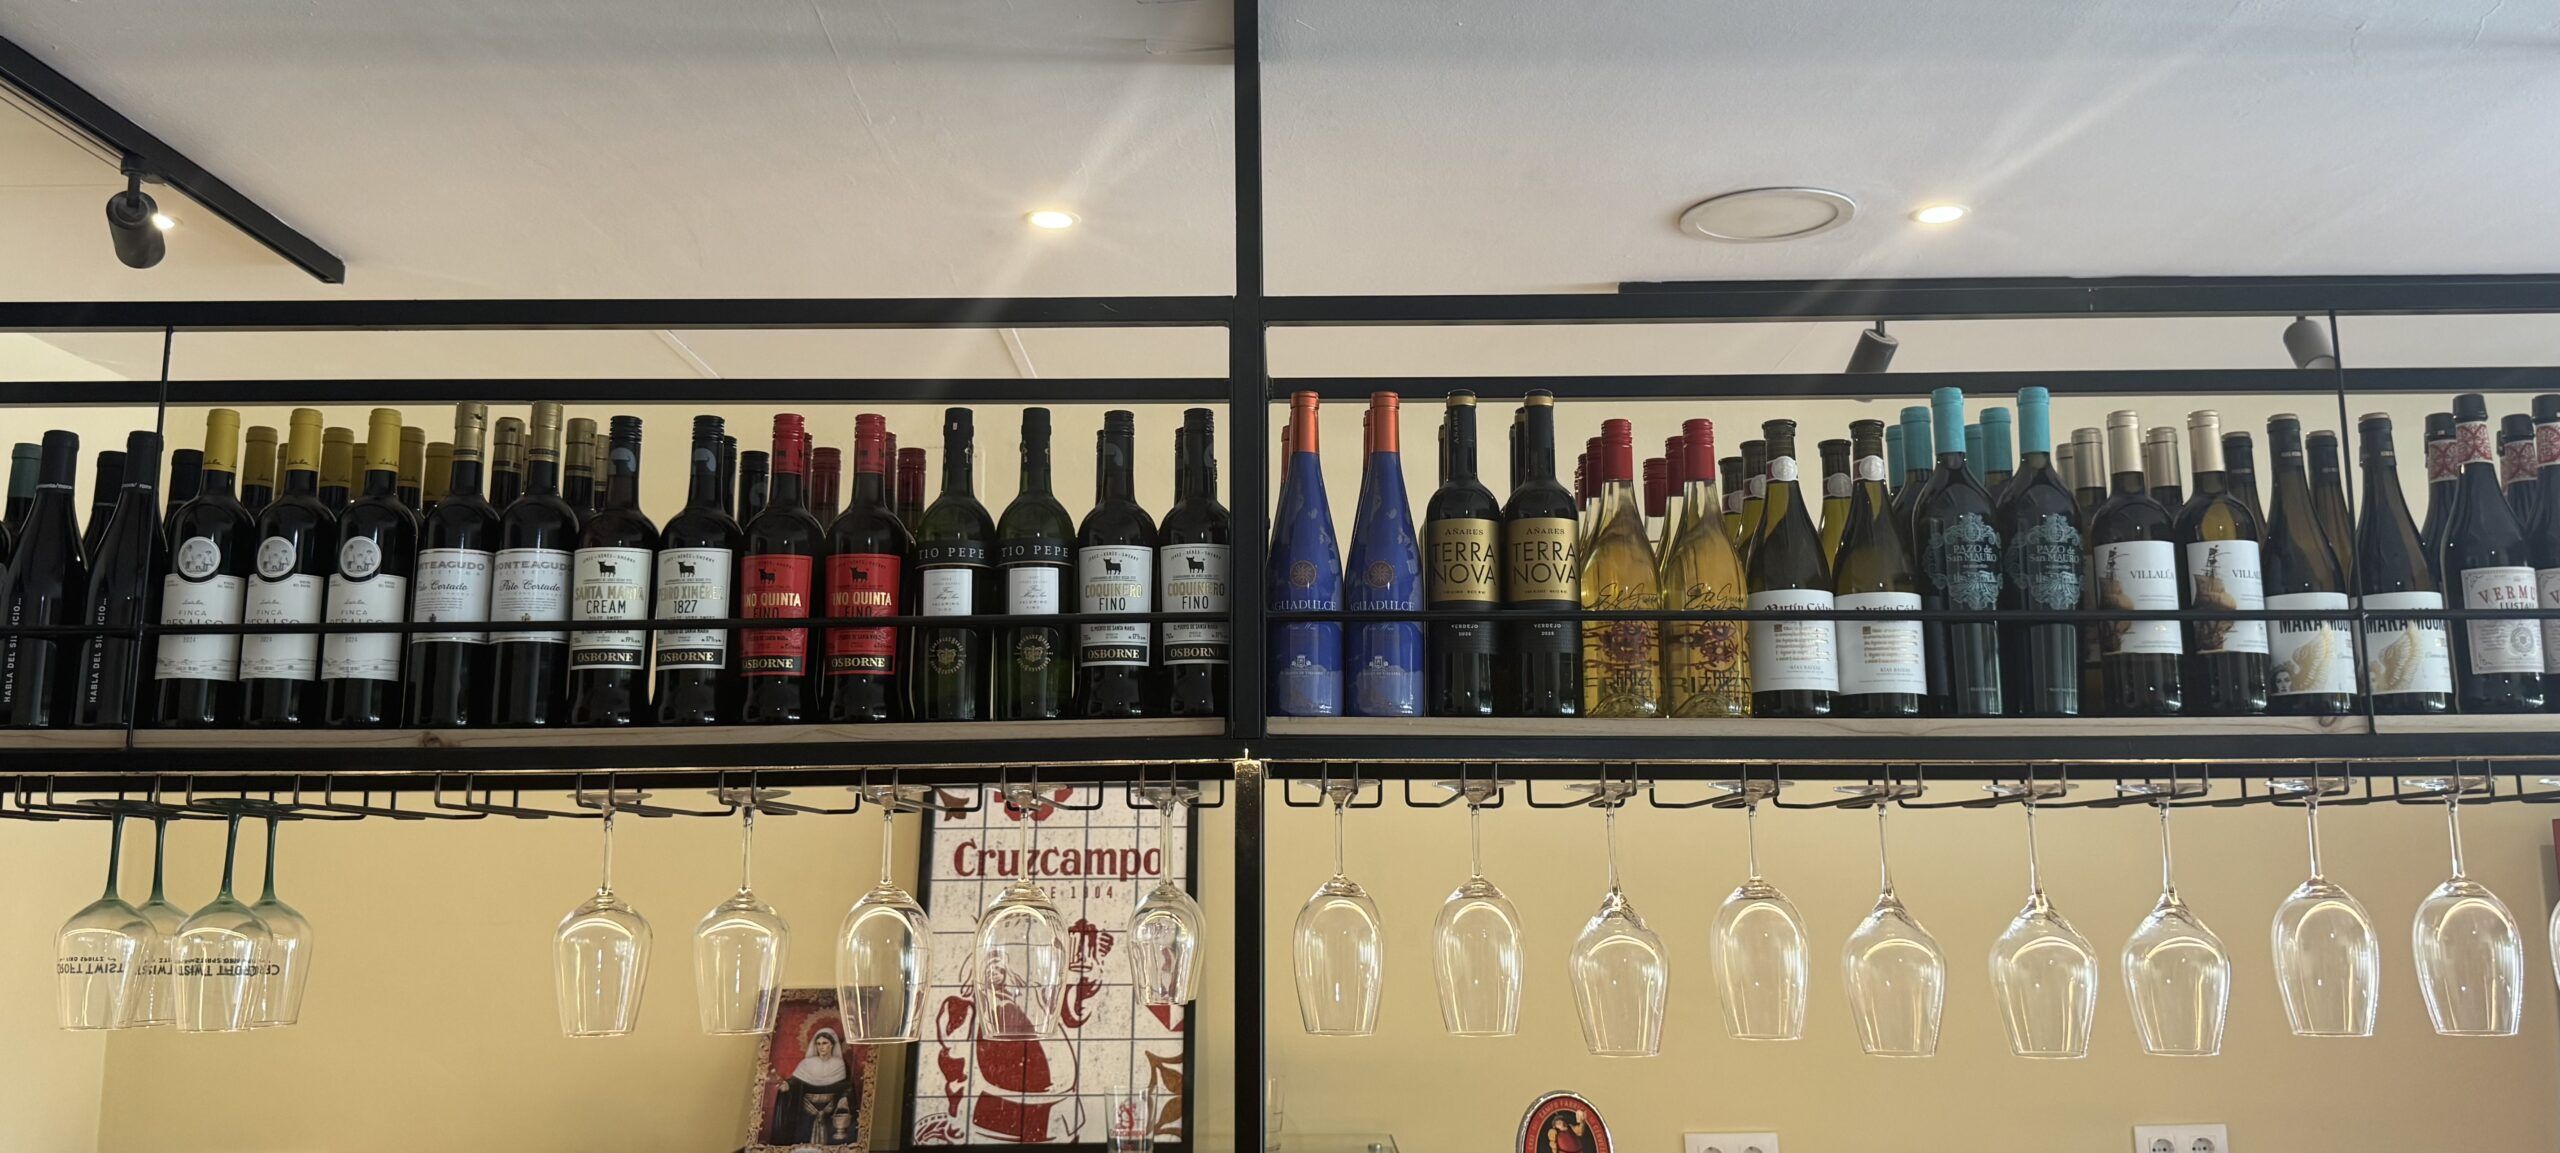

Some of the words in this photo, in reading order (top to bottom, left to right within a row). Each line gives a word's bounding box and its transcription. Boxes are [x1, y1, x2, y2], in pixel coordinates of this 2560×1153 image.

[1445, 528, 1484, 536] AÑARES
[1526, 527, 1565, 535] AÑARES
[919, 548, 939, 560] TIO
[948, 547, 985, 559] PEPE
[1001, 546, 1024, 558] TIO
[1034, 545, 1069, 557] PEPE
[1432, 542, 1496, 563] TERRA
[1512, 541, 1577, 562] TERRA
[1953, 545, 1982, 553] PAZO
[2036, 545, 2065, 554] PAZO
[1964, 553, 1997, 562] MAURO
[2048, 553, 2080, 563] MAURO
[1433, 564, 1496, 585] NOVA
[1514, 563, 1578, 585] NOVA
[523, 580, 561, 592] Cortado
[1085, 583, 1142, 598] COQUINERO
[1167, 582, 1225, 596] COQUINERO
[576, 586, 603, 600] SANTA
[761, 592, 801, 607] QUINTA
[853, 592, 892, 606] QUINTA
[2478, 585, 2536, 604] VERMU
[586, 600, 626, 613] CREAM
[674, 600, 697, 614] 1827
[1100, 597, 1126, 611] FINO
[1182, 596, 1209, 609] FINO
[753, 608, 779, 618] FINO
[845, 606, 872, 617] FINO
[10, 597, 21, 648] SILCIO...
[95, 597, 107, 648] SILCIO...
[577, 652, 633, 662] OSBORNE
[661, 651, 714, 662] OSBORNE
[1088, 649, 1140, 659] OSBORNE
[1171, 648, 1218, 658] OSBORN
[7, 651, 16, 669] DEL
[93, 652, 101, 669] DEL
[743, 658, 793, 668] OSBORNE
[832, 658, 885, 667] OSBORNE
[4, 672, 14, 702] HABLA
[90, 672, 99, 703] HABLA
[953, 839, 1162, 880] Cruzcampo
